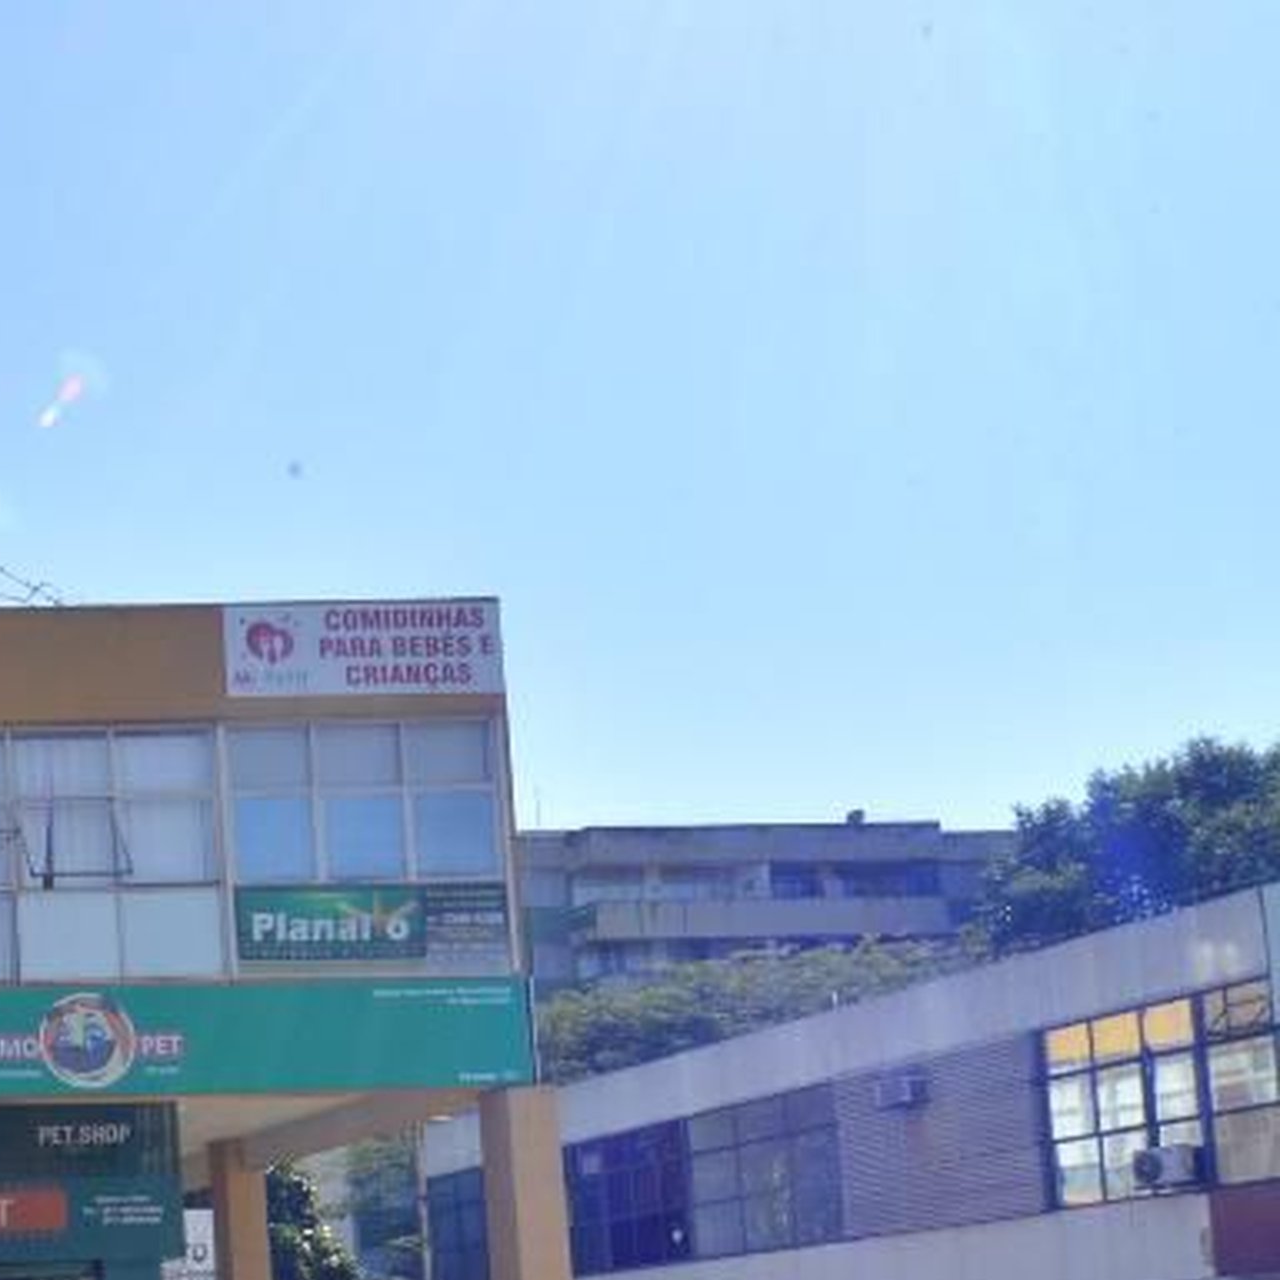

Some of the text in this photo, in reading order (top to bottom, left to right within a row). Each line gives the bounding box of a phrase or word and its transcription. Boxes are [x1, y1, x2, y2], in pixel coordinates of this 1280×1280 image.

[325, 607, 485, 632] COMIDINHAS
[319, 638, 381, 659] PARA
[481, 635, 493, 655] E
[346, 663, 472, 687] CRIANÇAS
[141, 1035, 183, 1055] PET
